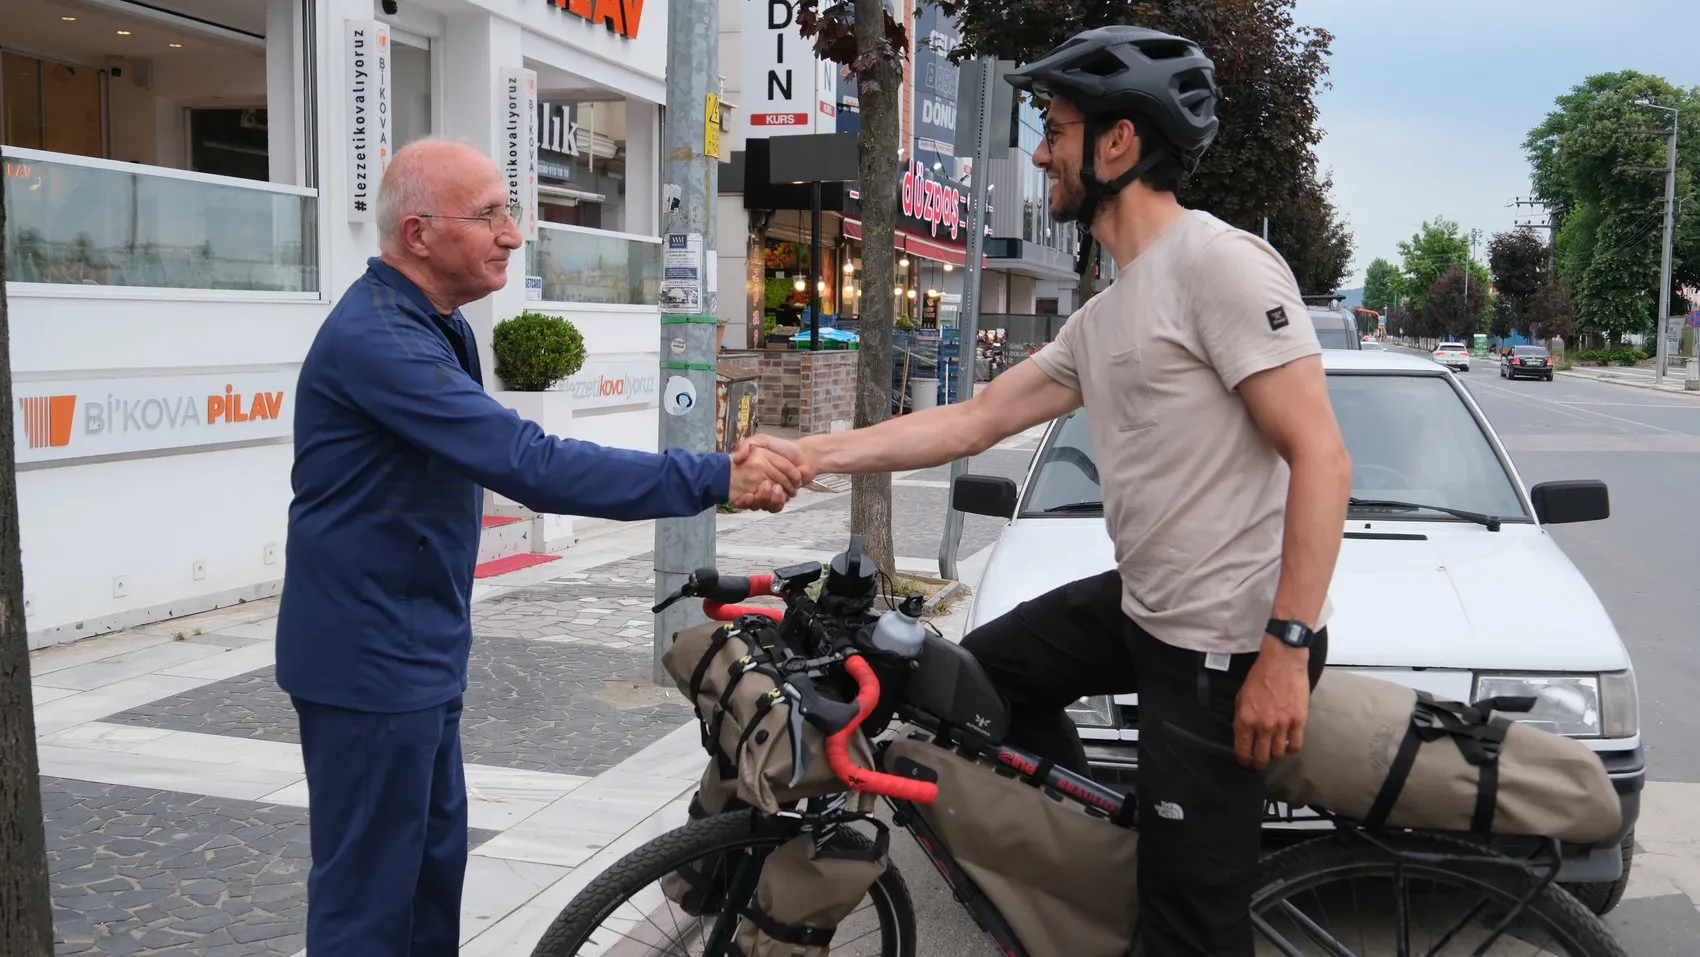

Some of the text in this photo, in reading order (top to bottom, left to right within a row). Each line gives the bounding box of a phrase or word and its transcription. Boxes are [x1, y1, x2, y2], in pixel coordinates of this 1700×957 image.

[353, 30, 368, 212] #lezzetikovalıyoruz
[506, 77, 520, 204] zzetikovalıyoruz
[537, 102, 580, 157] lık
[765, 114, 795, 125] KURS
[922, 96, 957, 130] DÖNÜ
[902, 158, 960, 240] düzpaş
[207, 384, 285, 425] PİLAV
